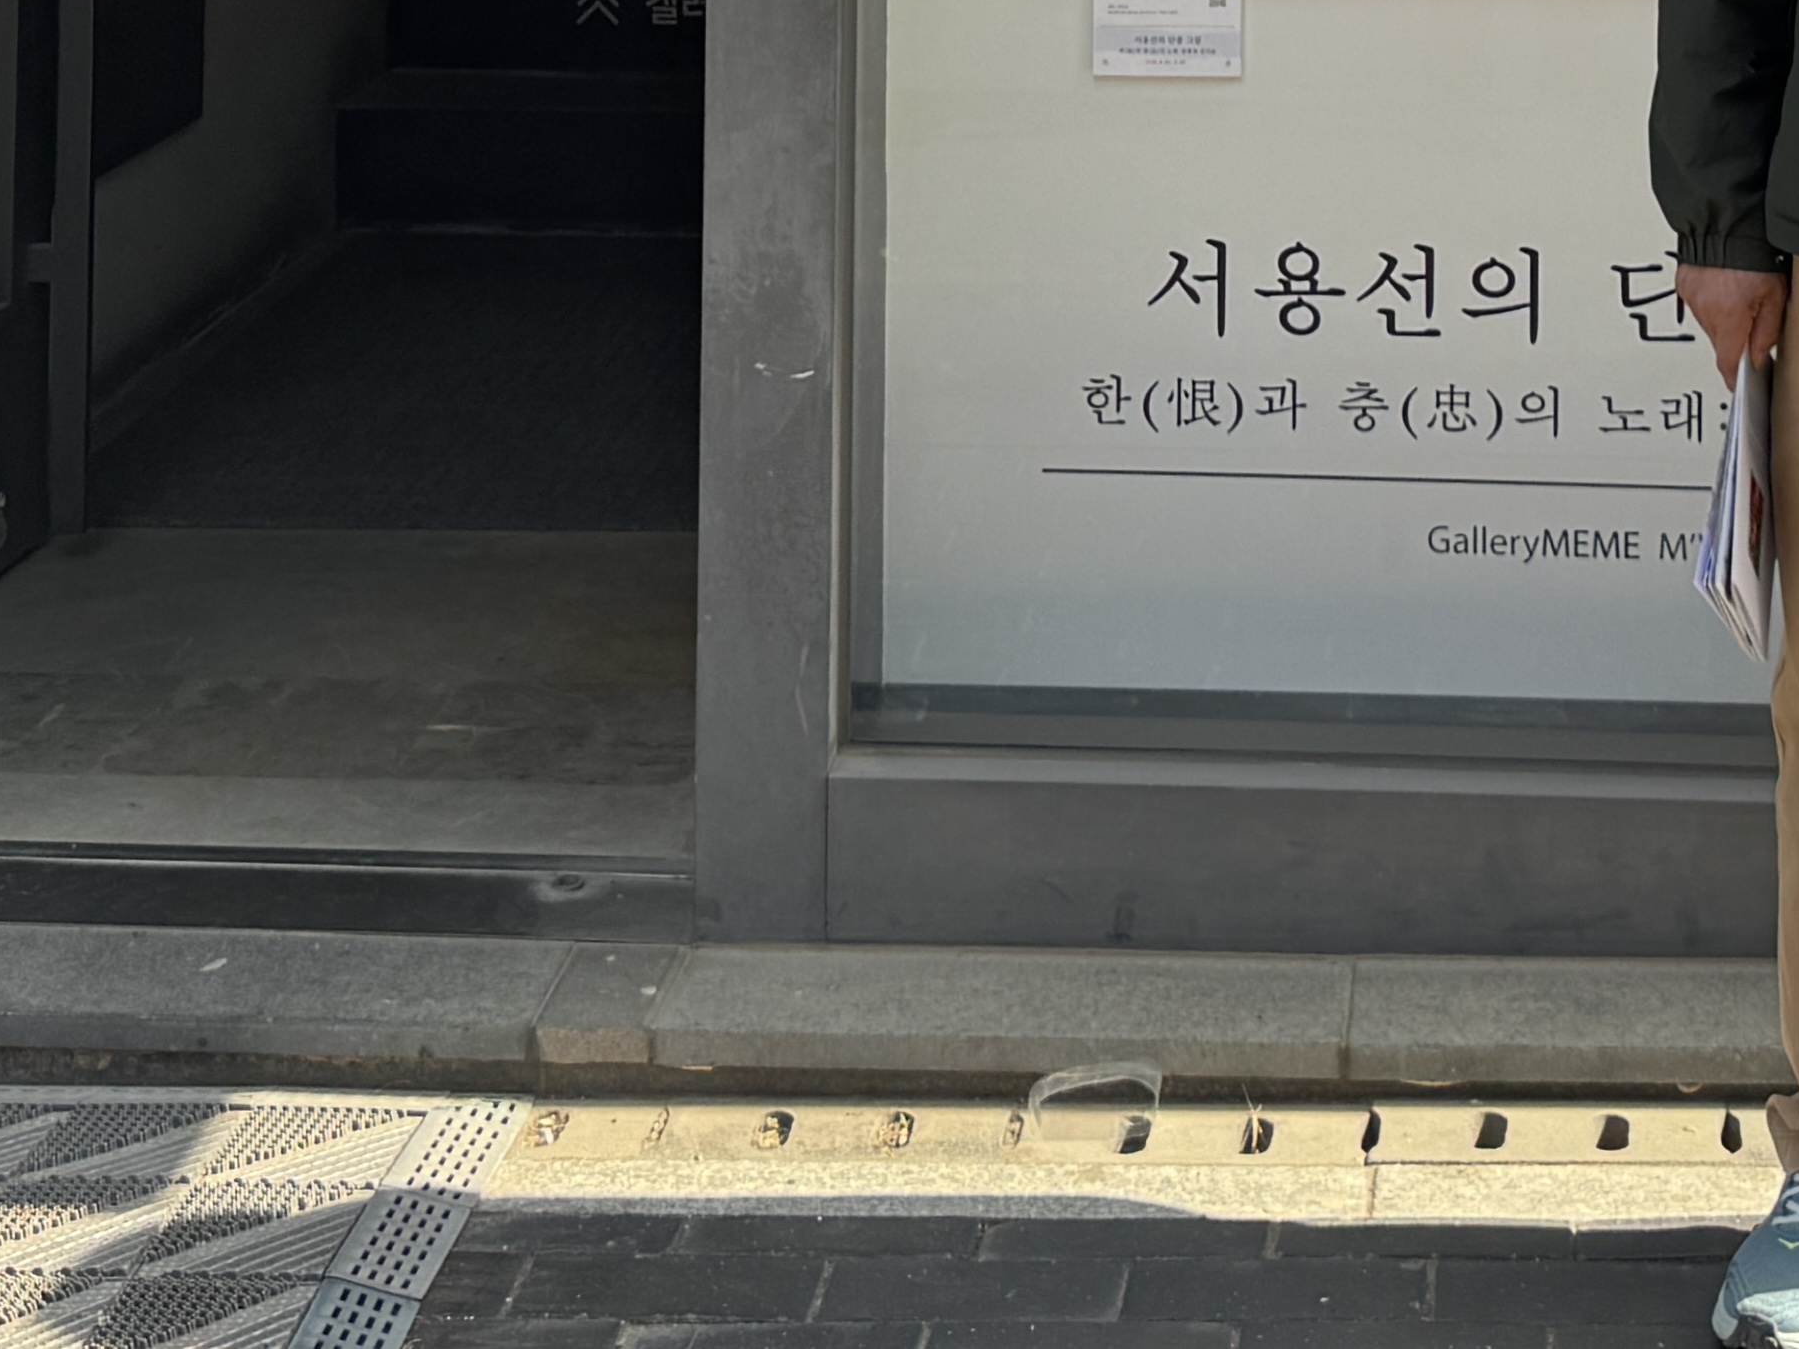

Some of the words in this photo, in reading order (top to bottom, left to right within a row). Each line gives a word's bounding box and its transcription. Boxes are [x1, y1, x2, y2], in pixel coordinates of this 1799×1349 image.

[1147, 238, 1541, 345] 서용선의
[1081, 373, 1308, 435] 한(恨)과
[1338, 381, 1562, 441] 충(忠)의
[1427, 525, 1642, 564] GalleryMEME
